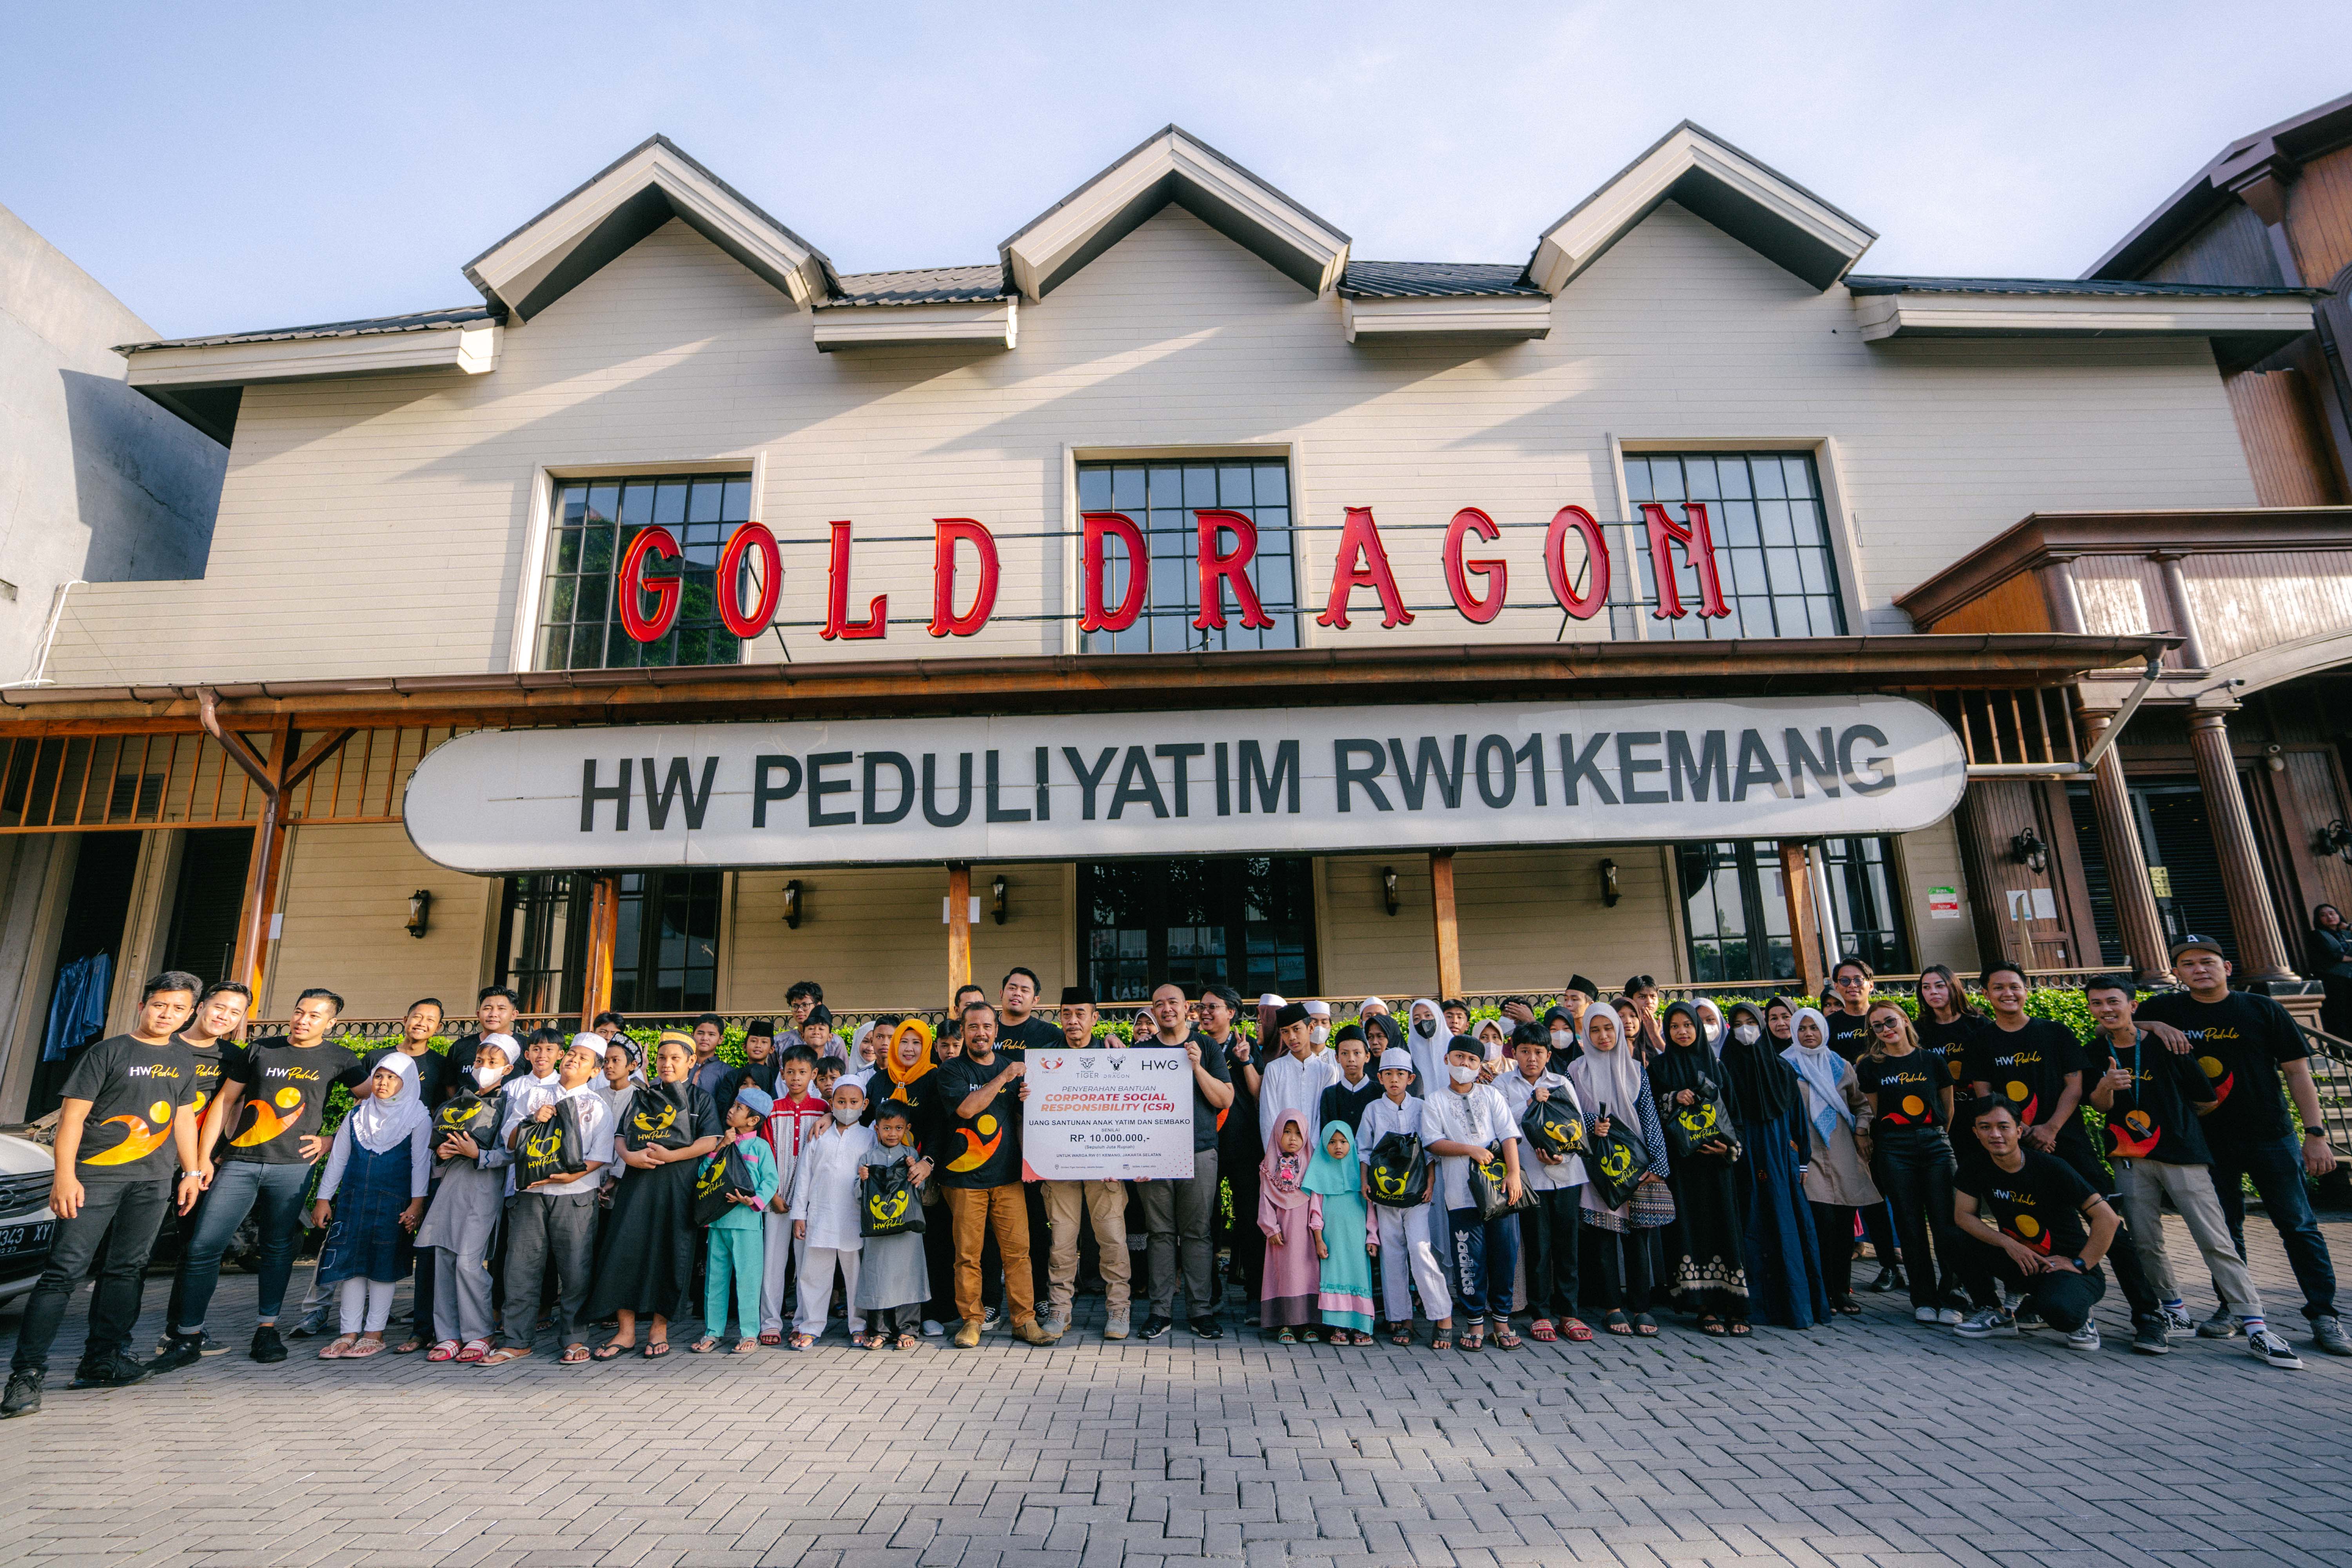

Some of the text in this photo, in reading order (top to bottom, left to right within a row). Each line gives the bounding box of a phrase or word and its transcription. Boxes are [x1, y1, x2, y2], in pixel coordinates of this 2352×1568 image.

[619, 503, 1731, 644] GOLD DRAGON
[579, 755, 719, 832] HW
[1142, 1060, 1178, 1070] HWG
[1045, 1093, 1167, 1102] CORPORATE SOCIAL
[1041, 1102, 1174, 1112] RESPONSIBILITY (CSR)
[1090, 1134, 1150, 1143] 10.000.000,-
[33, 1224, 51, 1241] XY
[1457, 1241, 1475, 1295] adidas
